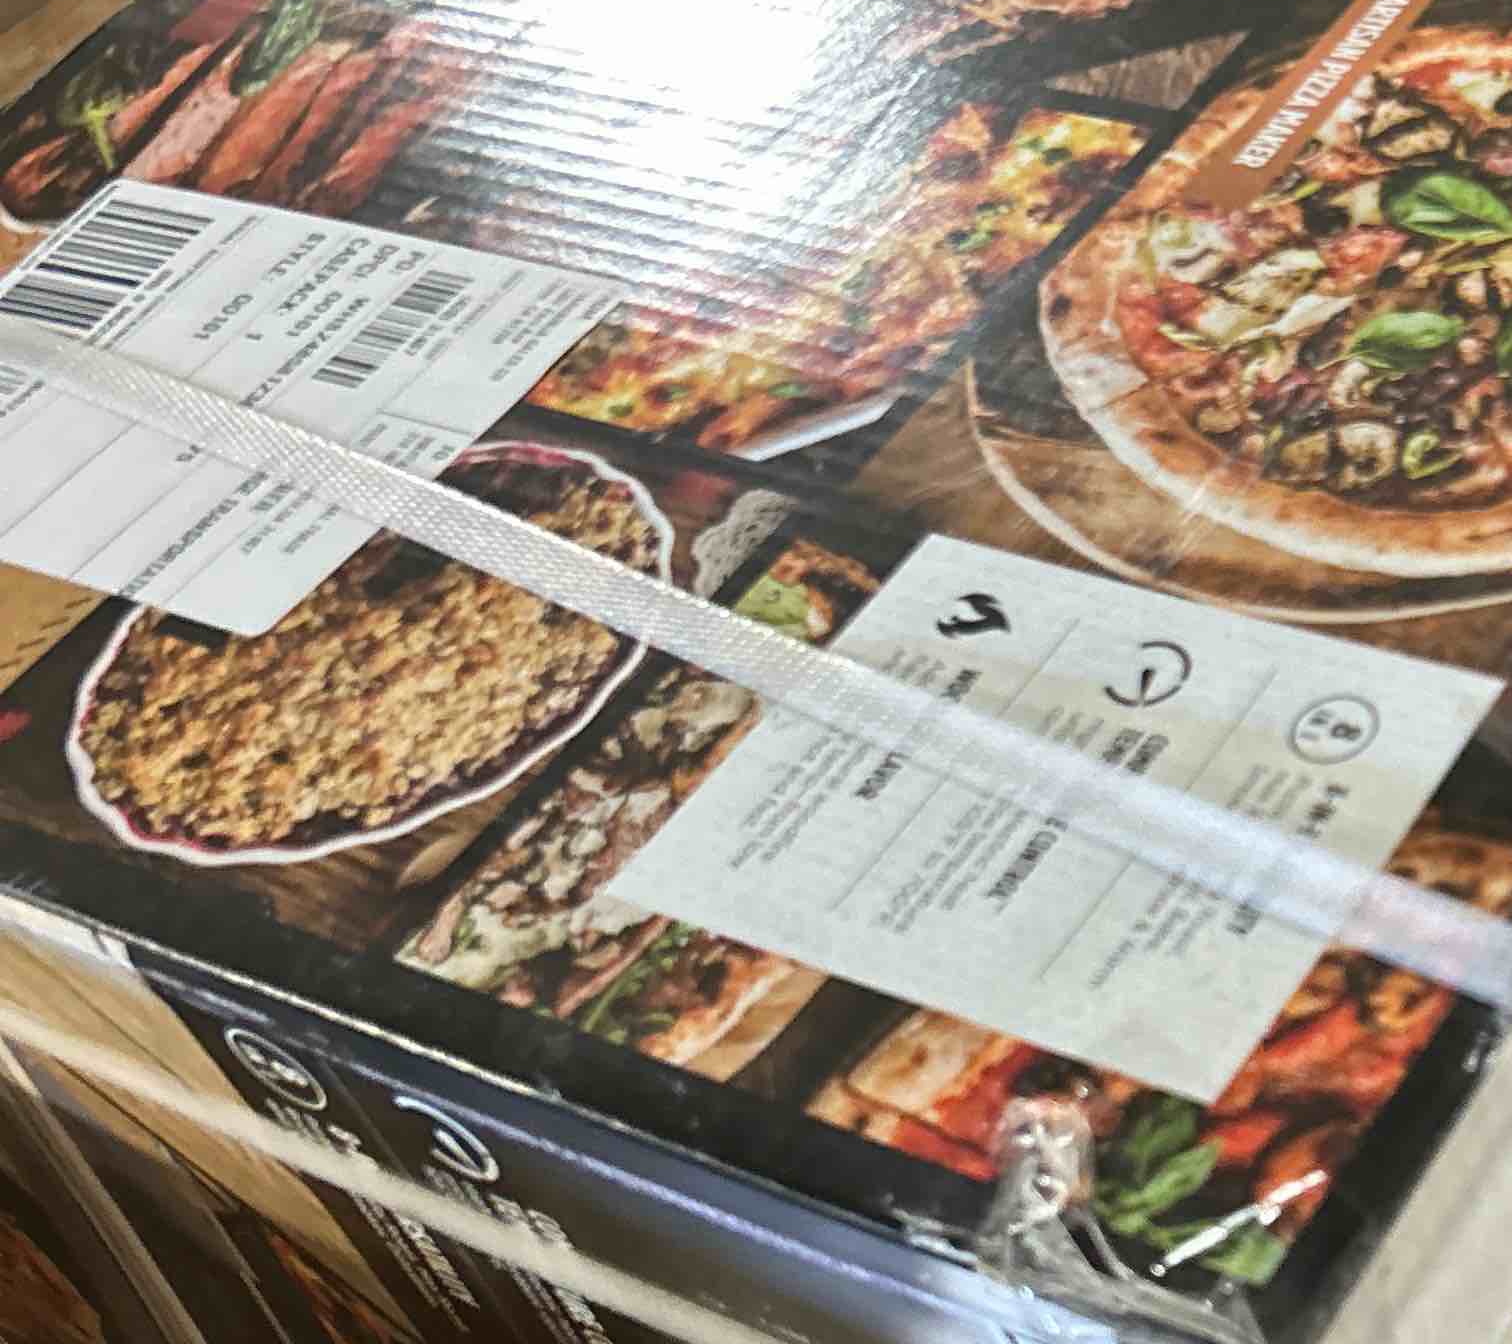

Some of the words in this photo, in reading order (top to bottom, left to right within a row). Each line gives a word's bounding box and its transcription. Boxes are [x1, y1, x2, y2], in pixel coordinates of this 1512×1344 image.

[1284, 58, 1357, 110] PIZZA
[1230, 108, 1312, 169] MAKER
[259, 232, 329, 282] STYLE:
